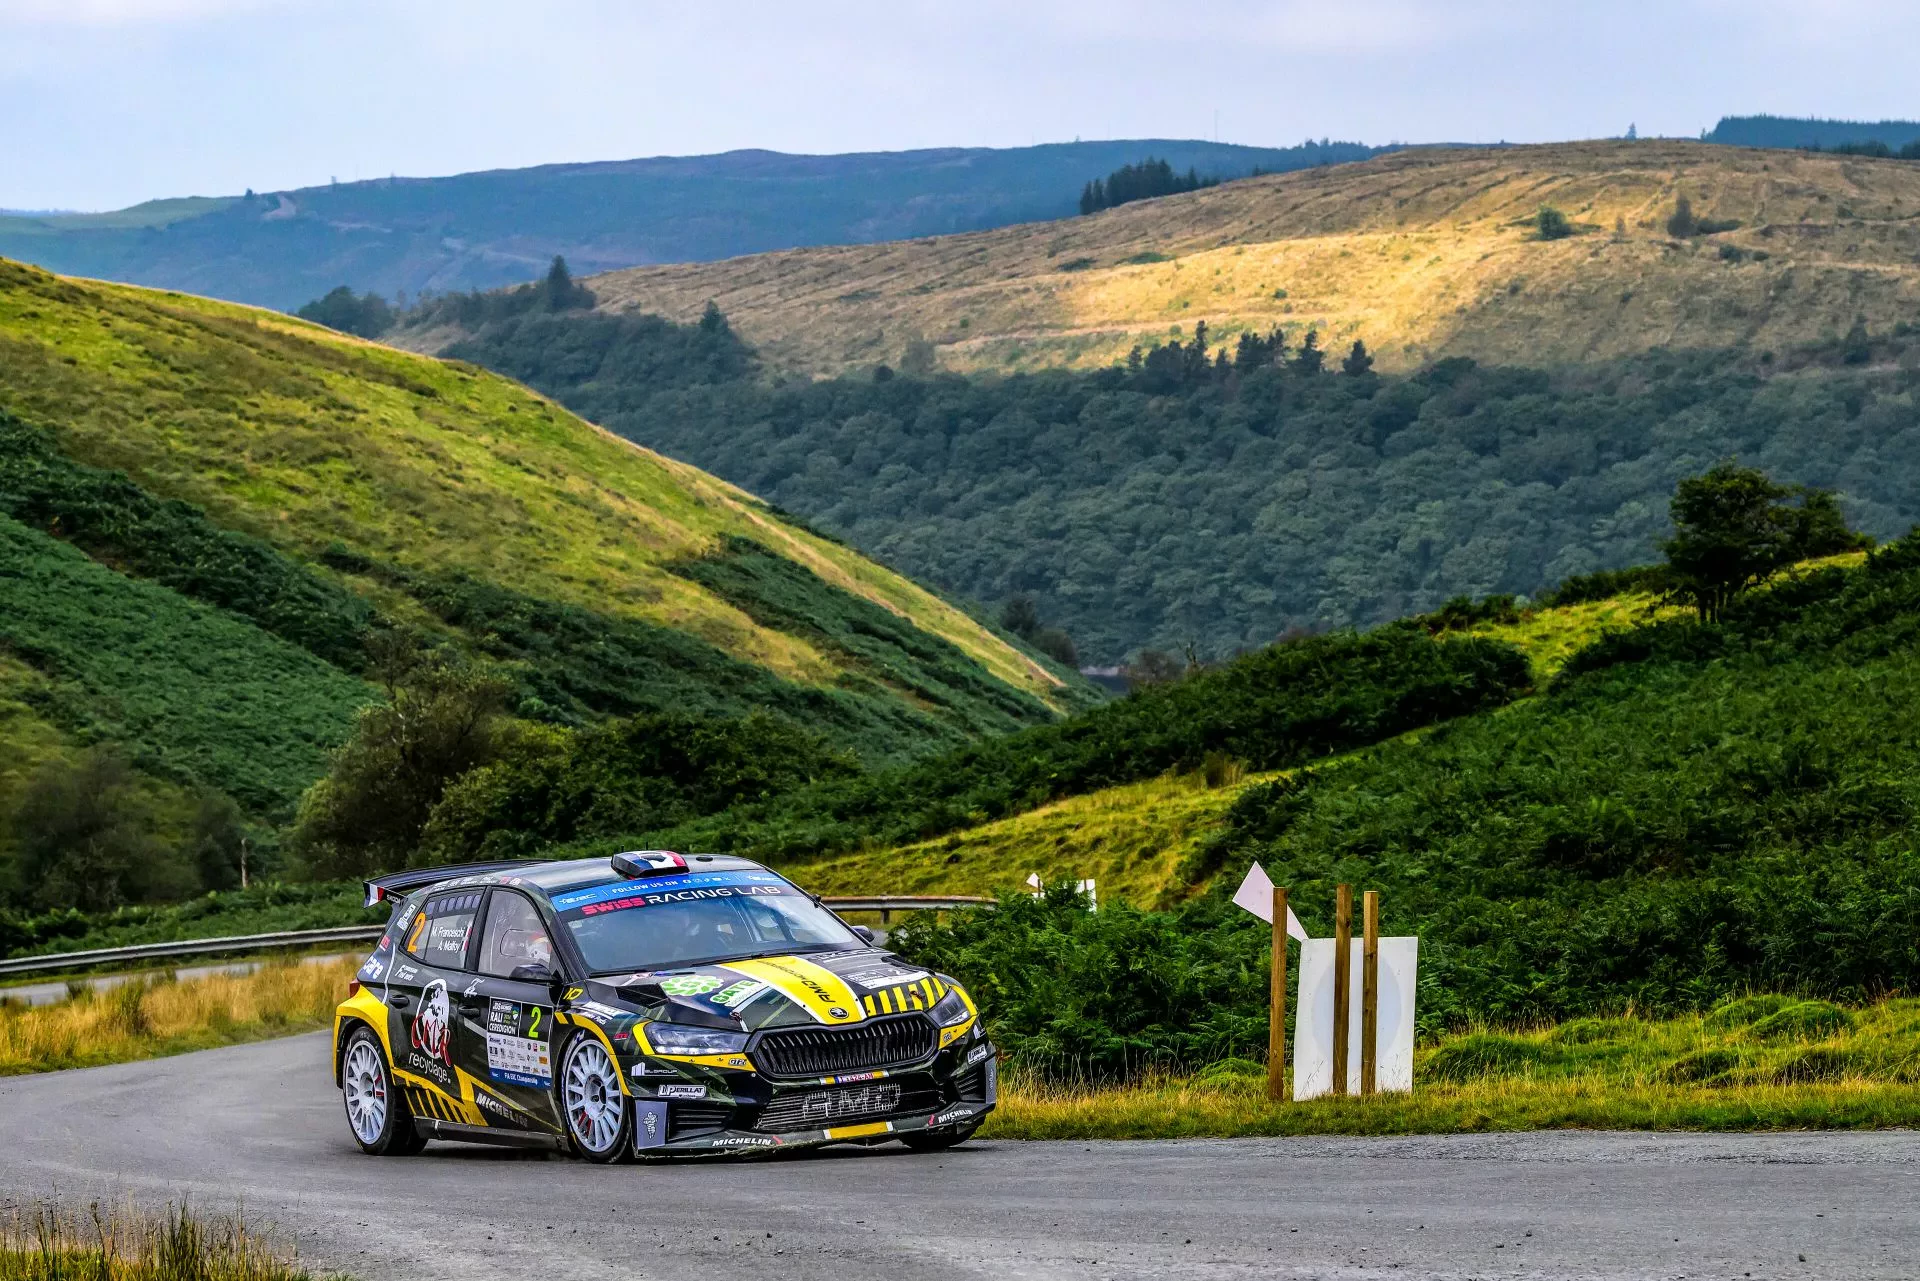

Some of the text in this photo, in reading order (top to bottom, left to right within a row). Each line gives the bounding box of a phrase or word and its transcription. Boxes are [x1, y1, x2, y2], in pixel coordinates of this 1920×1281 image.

[611, 883, 649, 894] FOLLOW
[651, 880, 664, 888] US
[581, 886, 782, 916] SWISS RACING LAB
[406, 912, 427, 953] 2
[490, 1011, 504, 1023] RALI
[528, 1006, 542, 1039] 2
[937, 1109, 973, 1124] MICHELIN
[712, 1137, 772, 1147] MICHELIN
